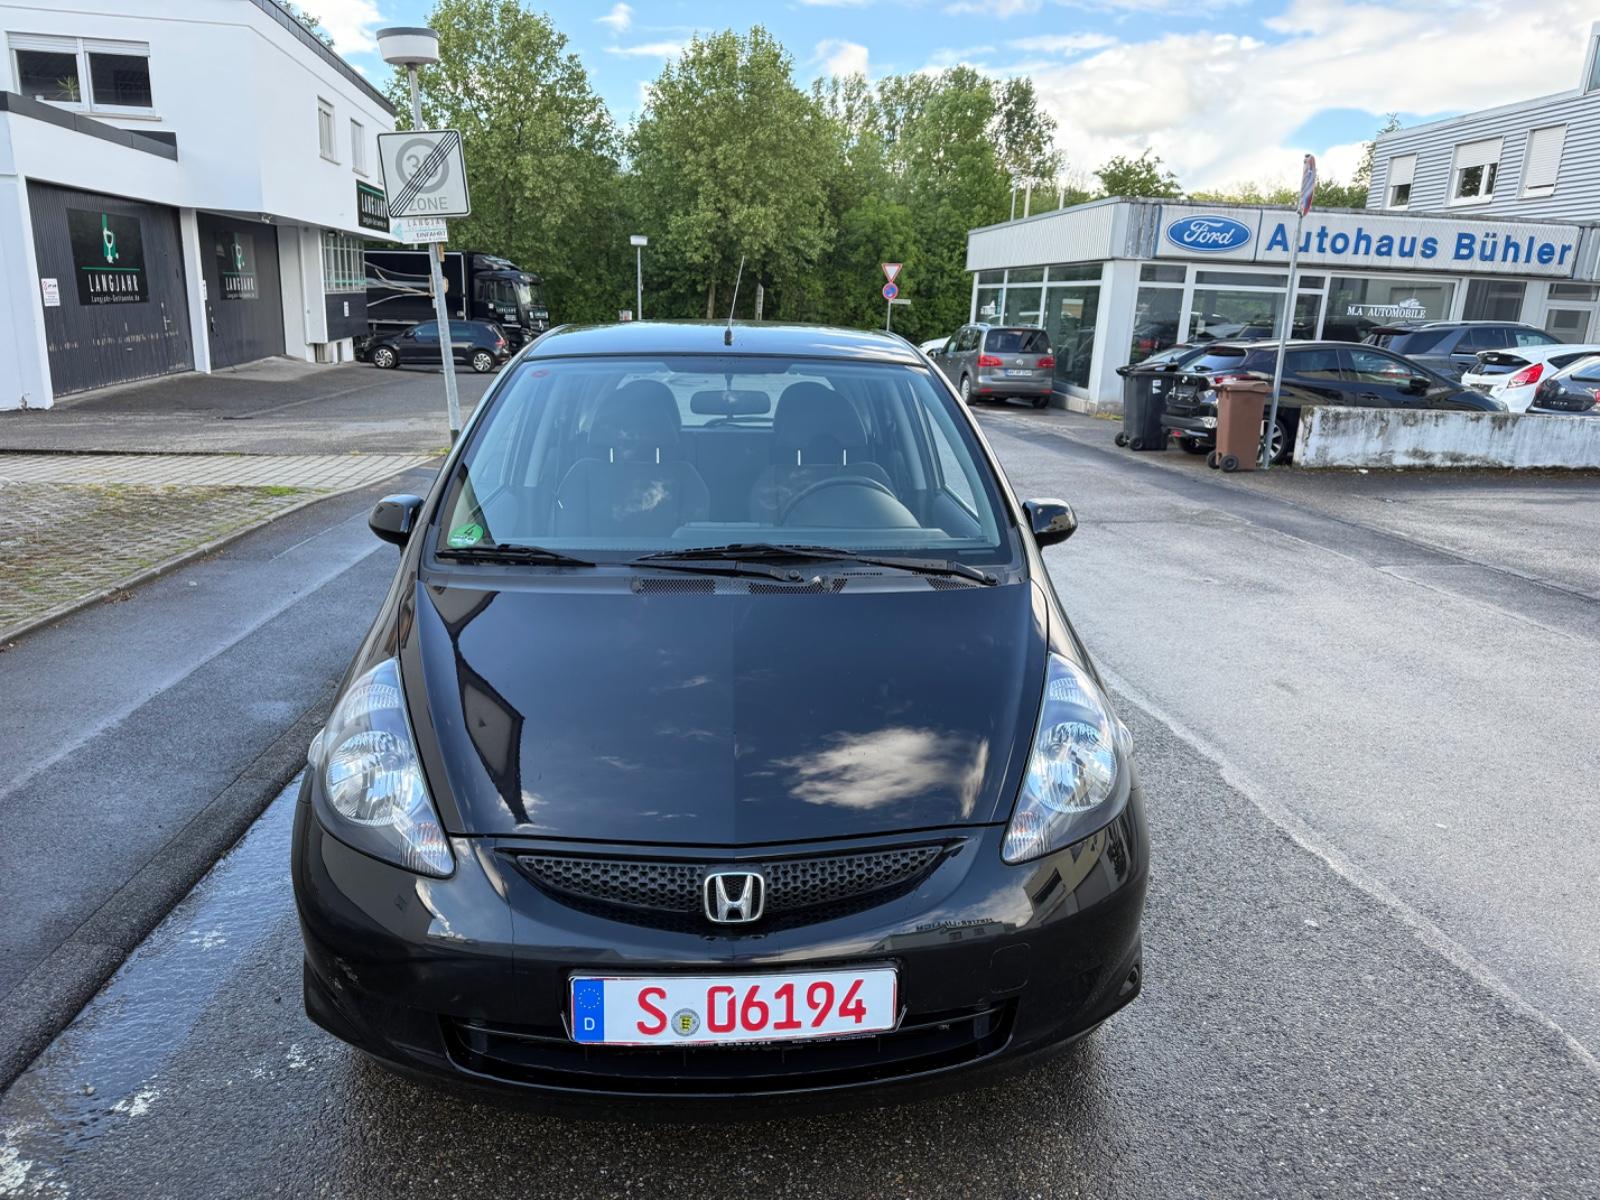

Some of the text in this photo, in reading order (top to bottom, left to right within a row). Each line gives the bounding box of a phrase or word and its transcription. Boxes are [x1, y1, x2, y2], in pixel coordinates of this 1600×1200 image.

[406, 153, 438, 178] 3
[409, 196, 448, 212] ZONE
[1183, 219, 1233, 245] Ford
[1265, 223, 1572, 265] Autohaus Bühler
[88, 274, 139, 292] LANGJAHR
[1367, 307, 1426, 319] AUTOMOBILE
[636, 978, 867, 1035] S 06194
[584, 1017, 596, 1031] D
